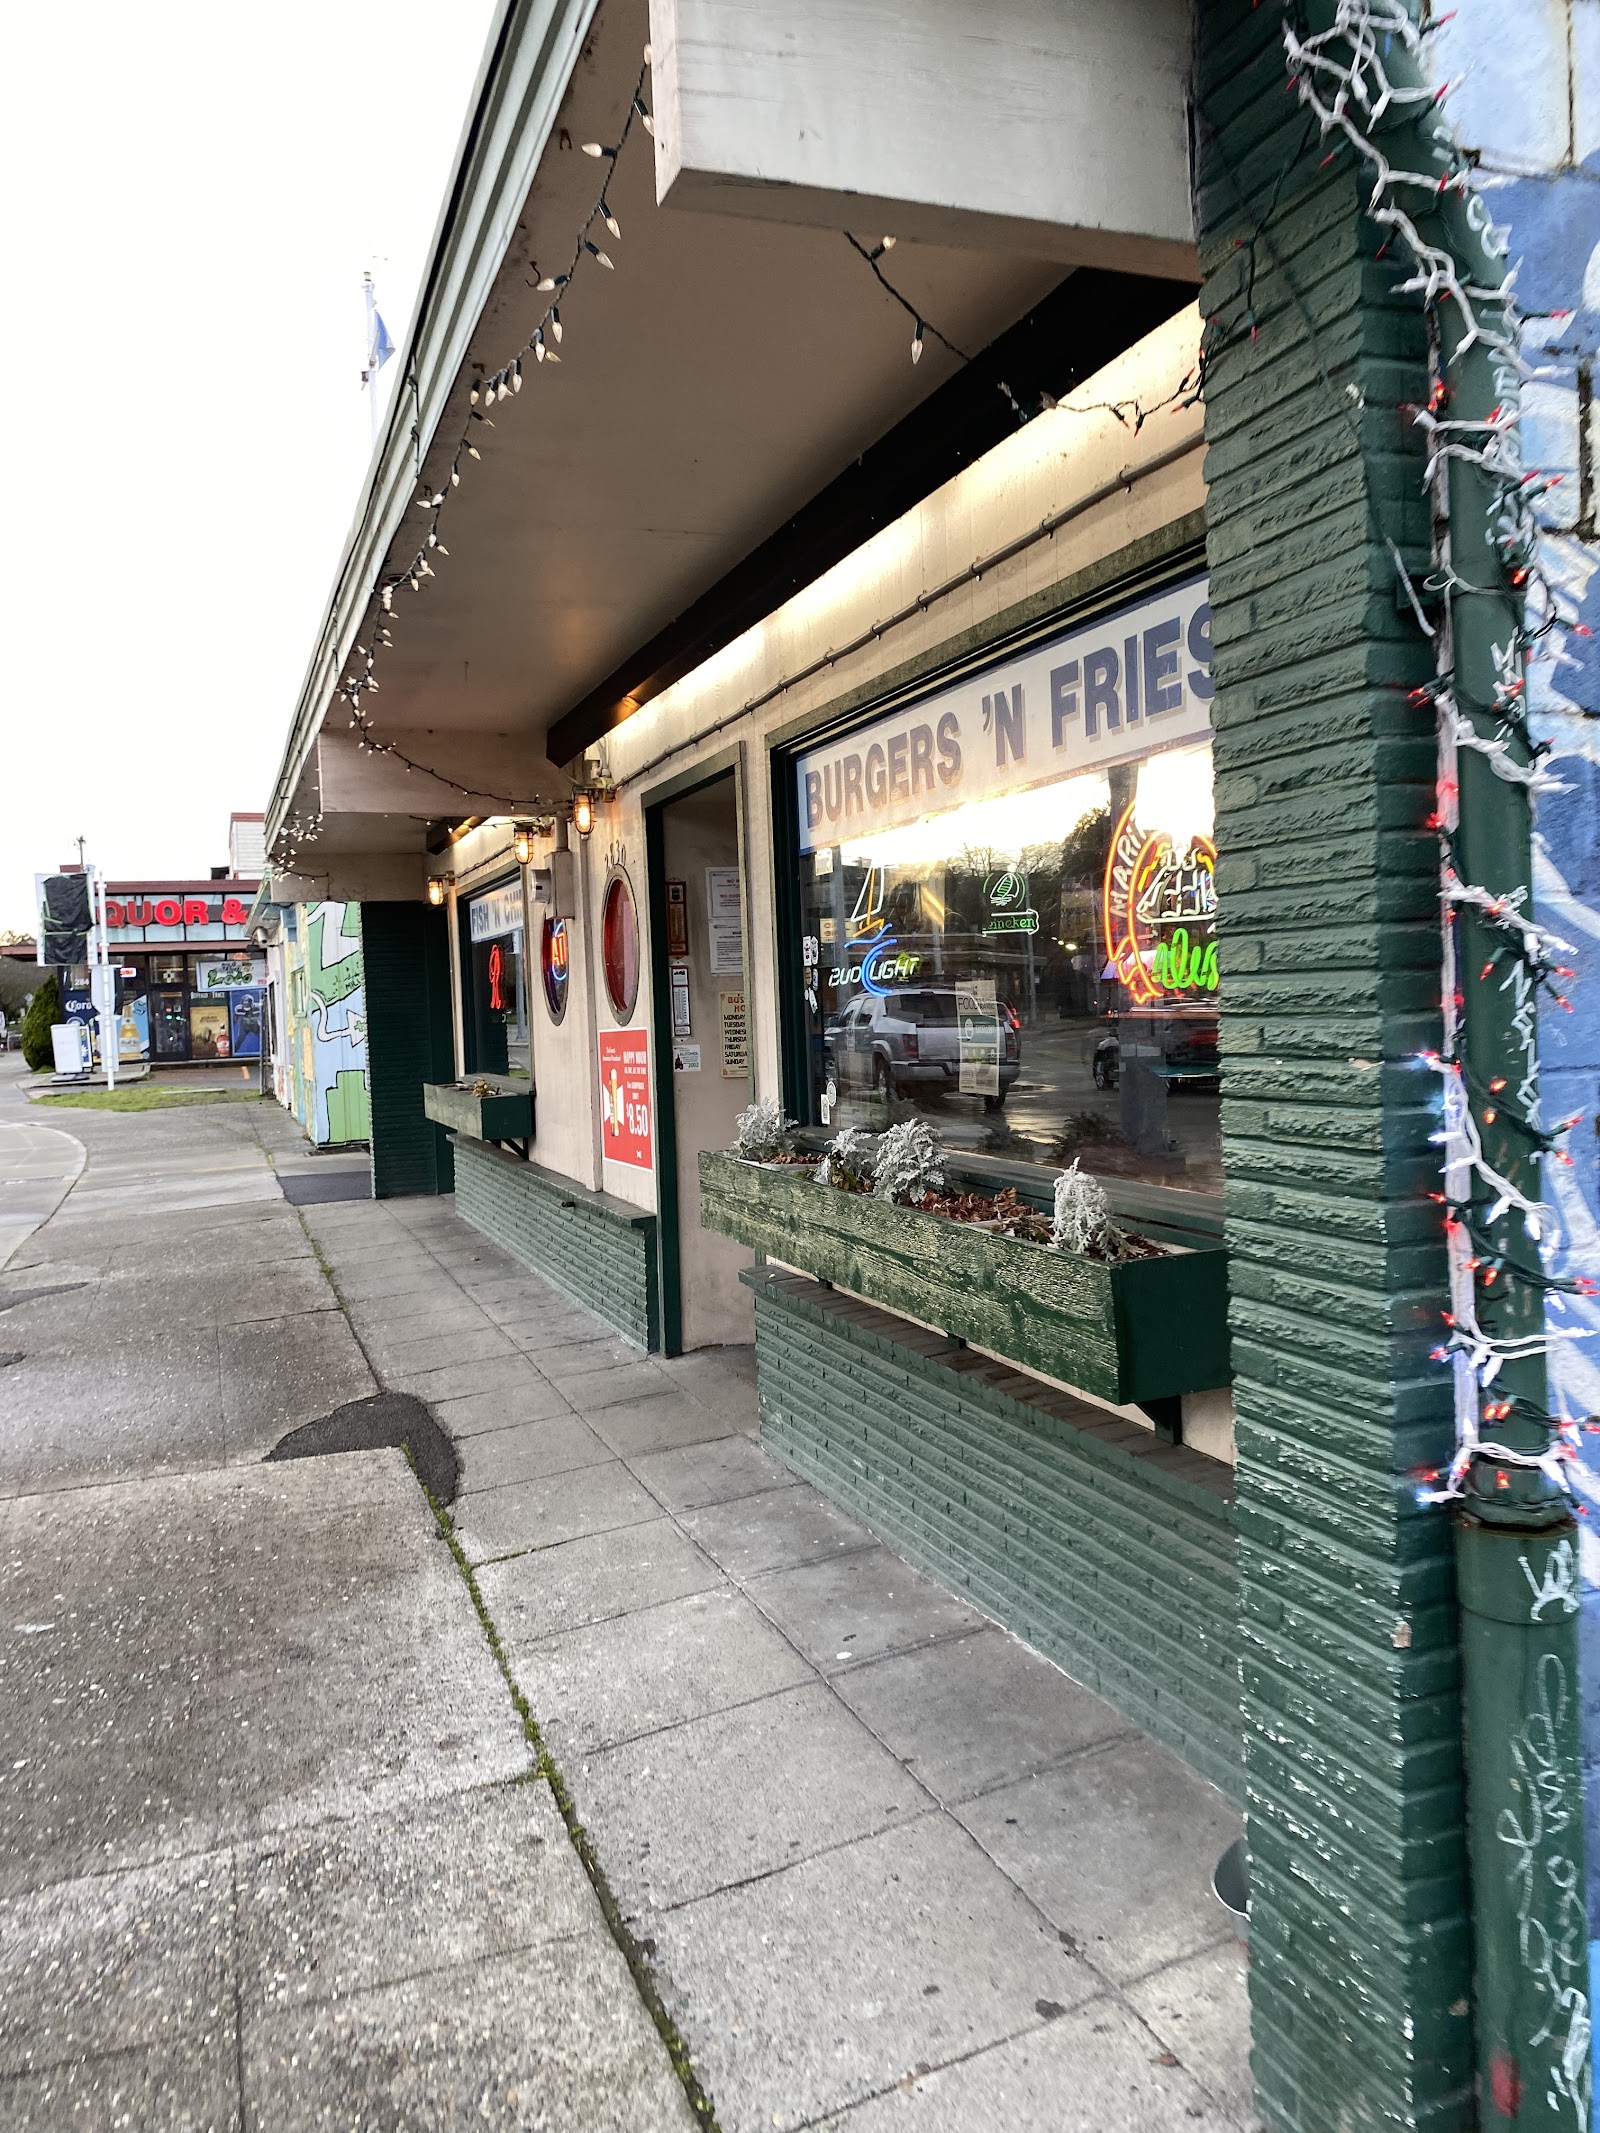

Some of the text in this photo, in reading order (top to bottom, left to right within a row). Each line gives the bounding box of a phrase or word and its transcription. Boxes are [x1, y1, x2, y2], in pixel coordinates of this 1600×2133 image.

[806, 602, 1214, 829] BURGERS 'N FRIES
[471, 902, 489, 936] FISH
[869, 957, 920, 981] LIGHT
[626, 1103, 648, 1137] $8.50
